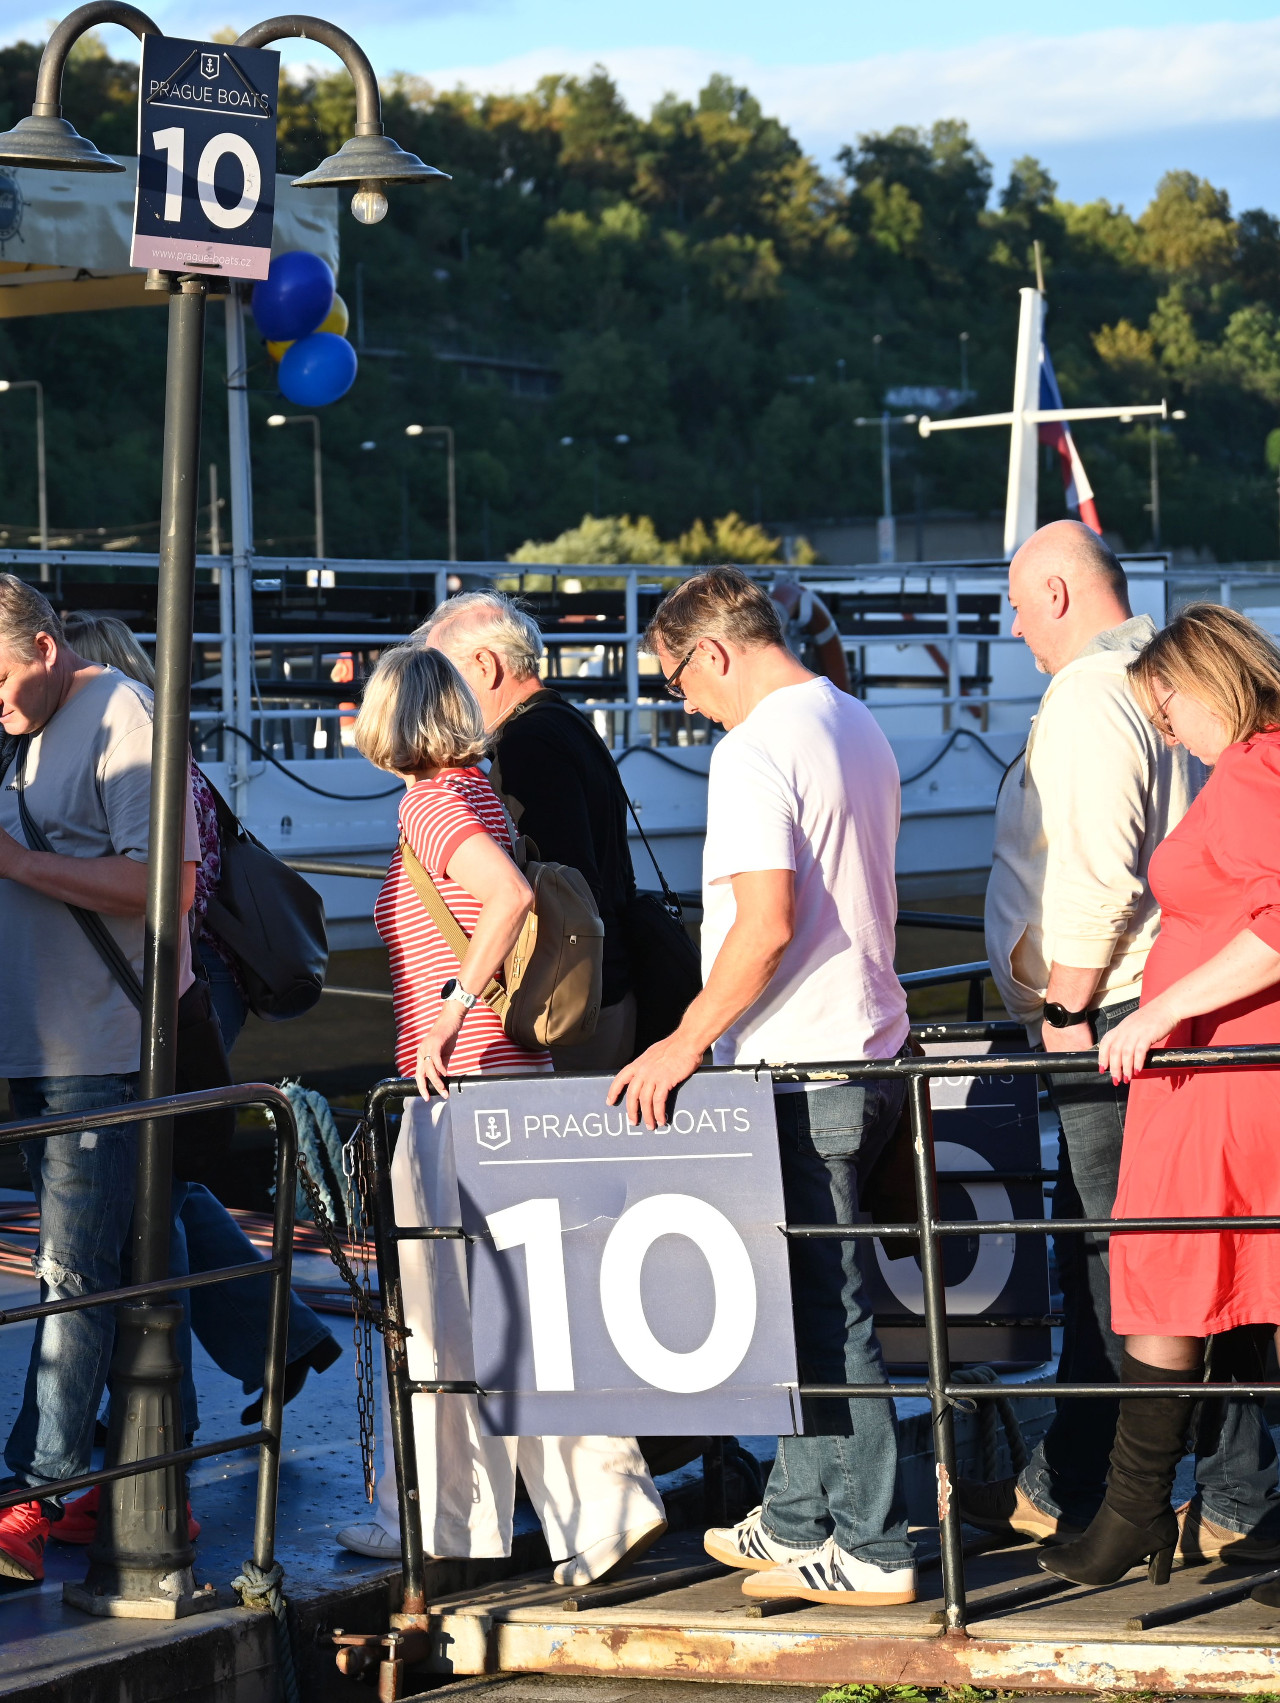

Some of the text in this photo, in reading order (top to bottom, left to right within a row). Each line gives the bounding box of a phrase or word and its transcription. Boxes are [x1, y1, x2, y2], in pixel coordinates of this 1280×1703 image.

[149, 79, 269, 110] PRAGUE BOATS
[152, 126, 262, 230] 10
[151, 248, 253, 268] www.prague-boats.cz
[524, 1107, 751, 1139] PRAGUE BOATS
[485, 1193, 757, 1394] 10
